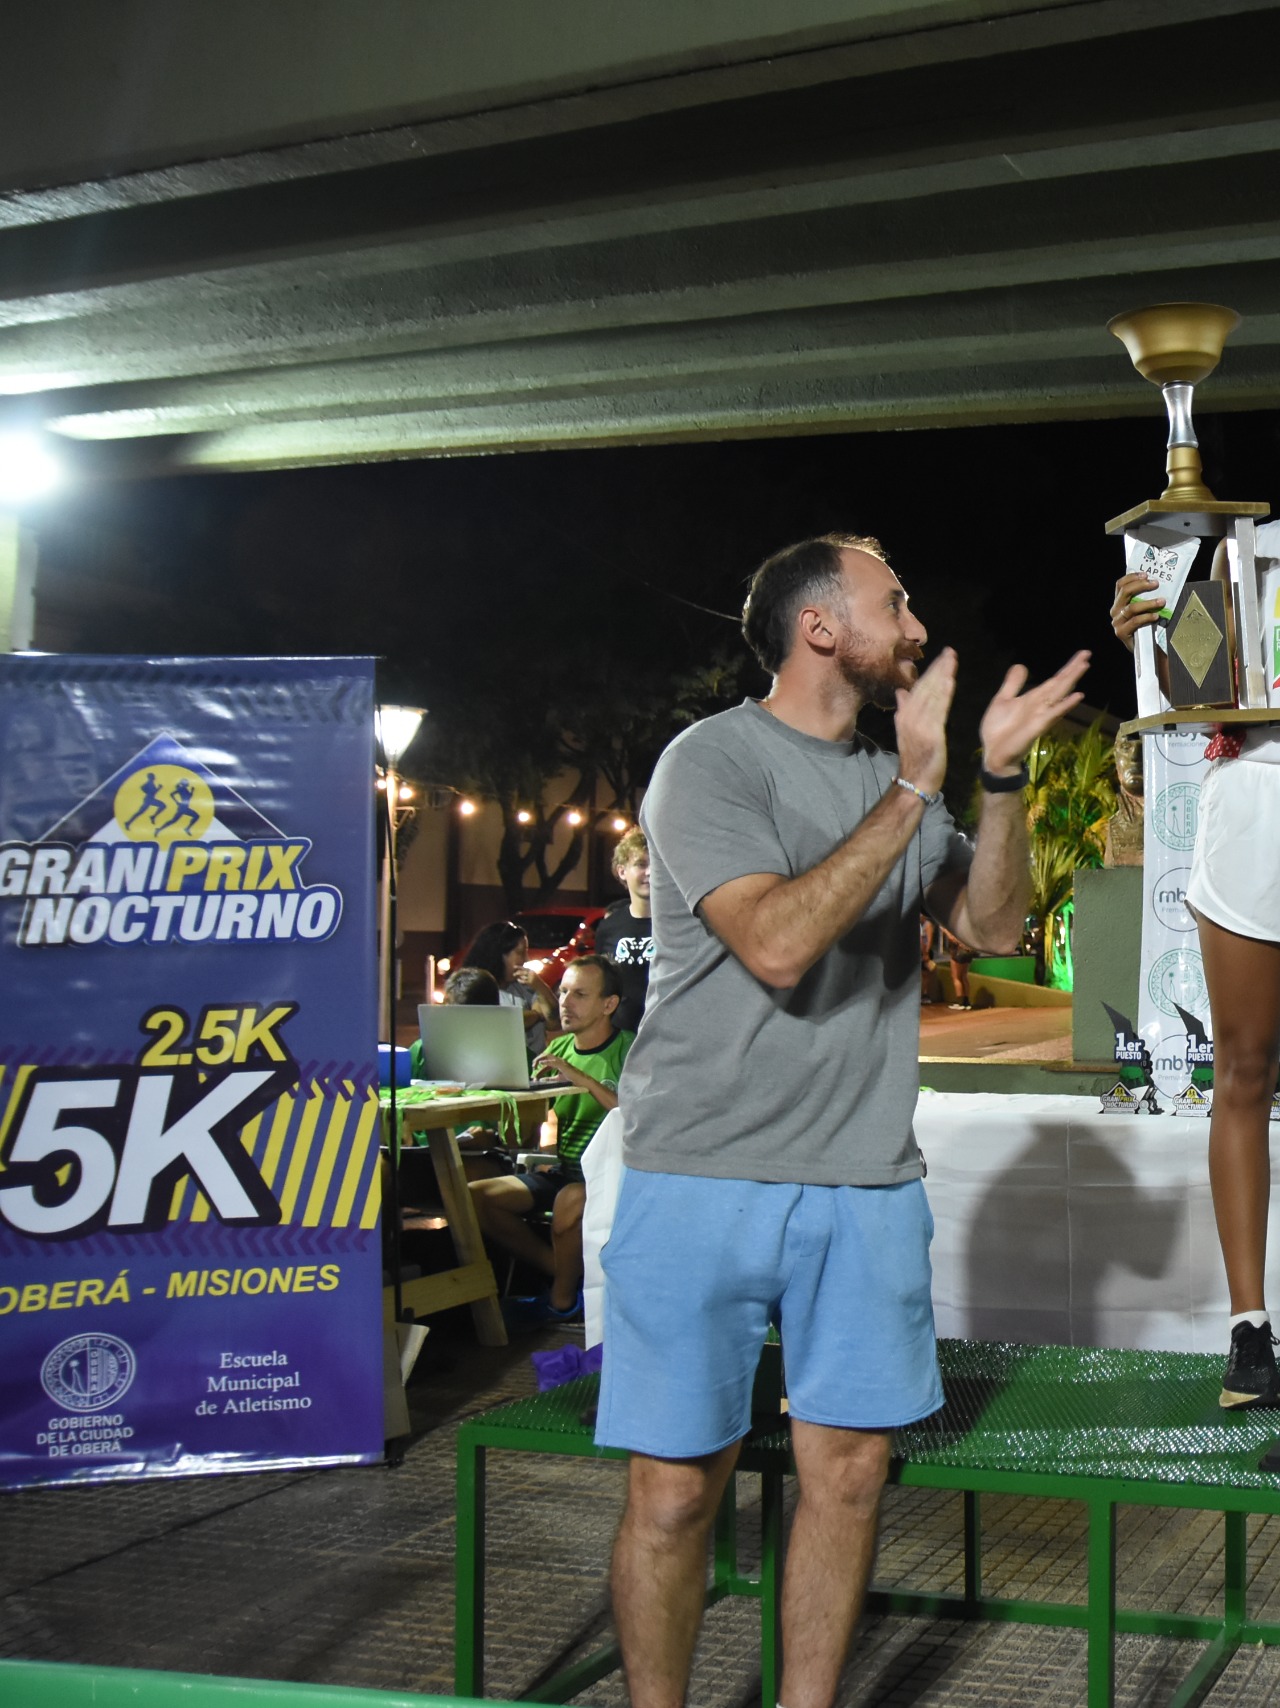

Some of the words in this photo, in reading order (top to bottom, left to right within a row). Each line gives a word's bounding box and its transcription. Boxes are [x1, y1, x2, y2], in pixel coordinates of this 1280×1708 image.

[166, 845, 303, 892] PRIX
[25, 892, 337, 944] NOCTURNO
[141, 1006, 294, 1067] 2.5K
[1115, 1032, 1142, 1052] 1er
[1187, 1034, 1214, 1053] 1er
[1116, 1052, 1142, 1061] PUESTO
[1187, 1053, 1214, 1062] PUESTO
[0, 1071, 277, 1234] 5K
[0, 1268, 131, 1315] OBERÁ
[166, 1264, 340, 1299] MISIONES
[219, 1350, 288, 1369] Escuela
[206, 1372, 300, 1393] Municipal
[195, 1400, 217, 1416] de
[223, 1395, 312, 1414] Atletismo
[48, 1413, 123, 1430] GOBIERNO
[36, 1431, 56, 1445] DE
[58, 1430, 76, 1443] LA
[79, 1426, 134, 1442] CIUDAD
[49, 1444, 68, 1457] DE
[74, 1440, 122, 1456] OBERÁ
